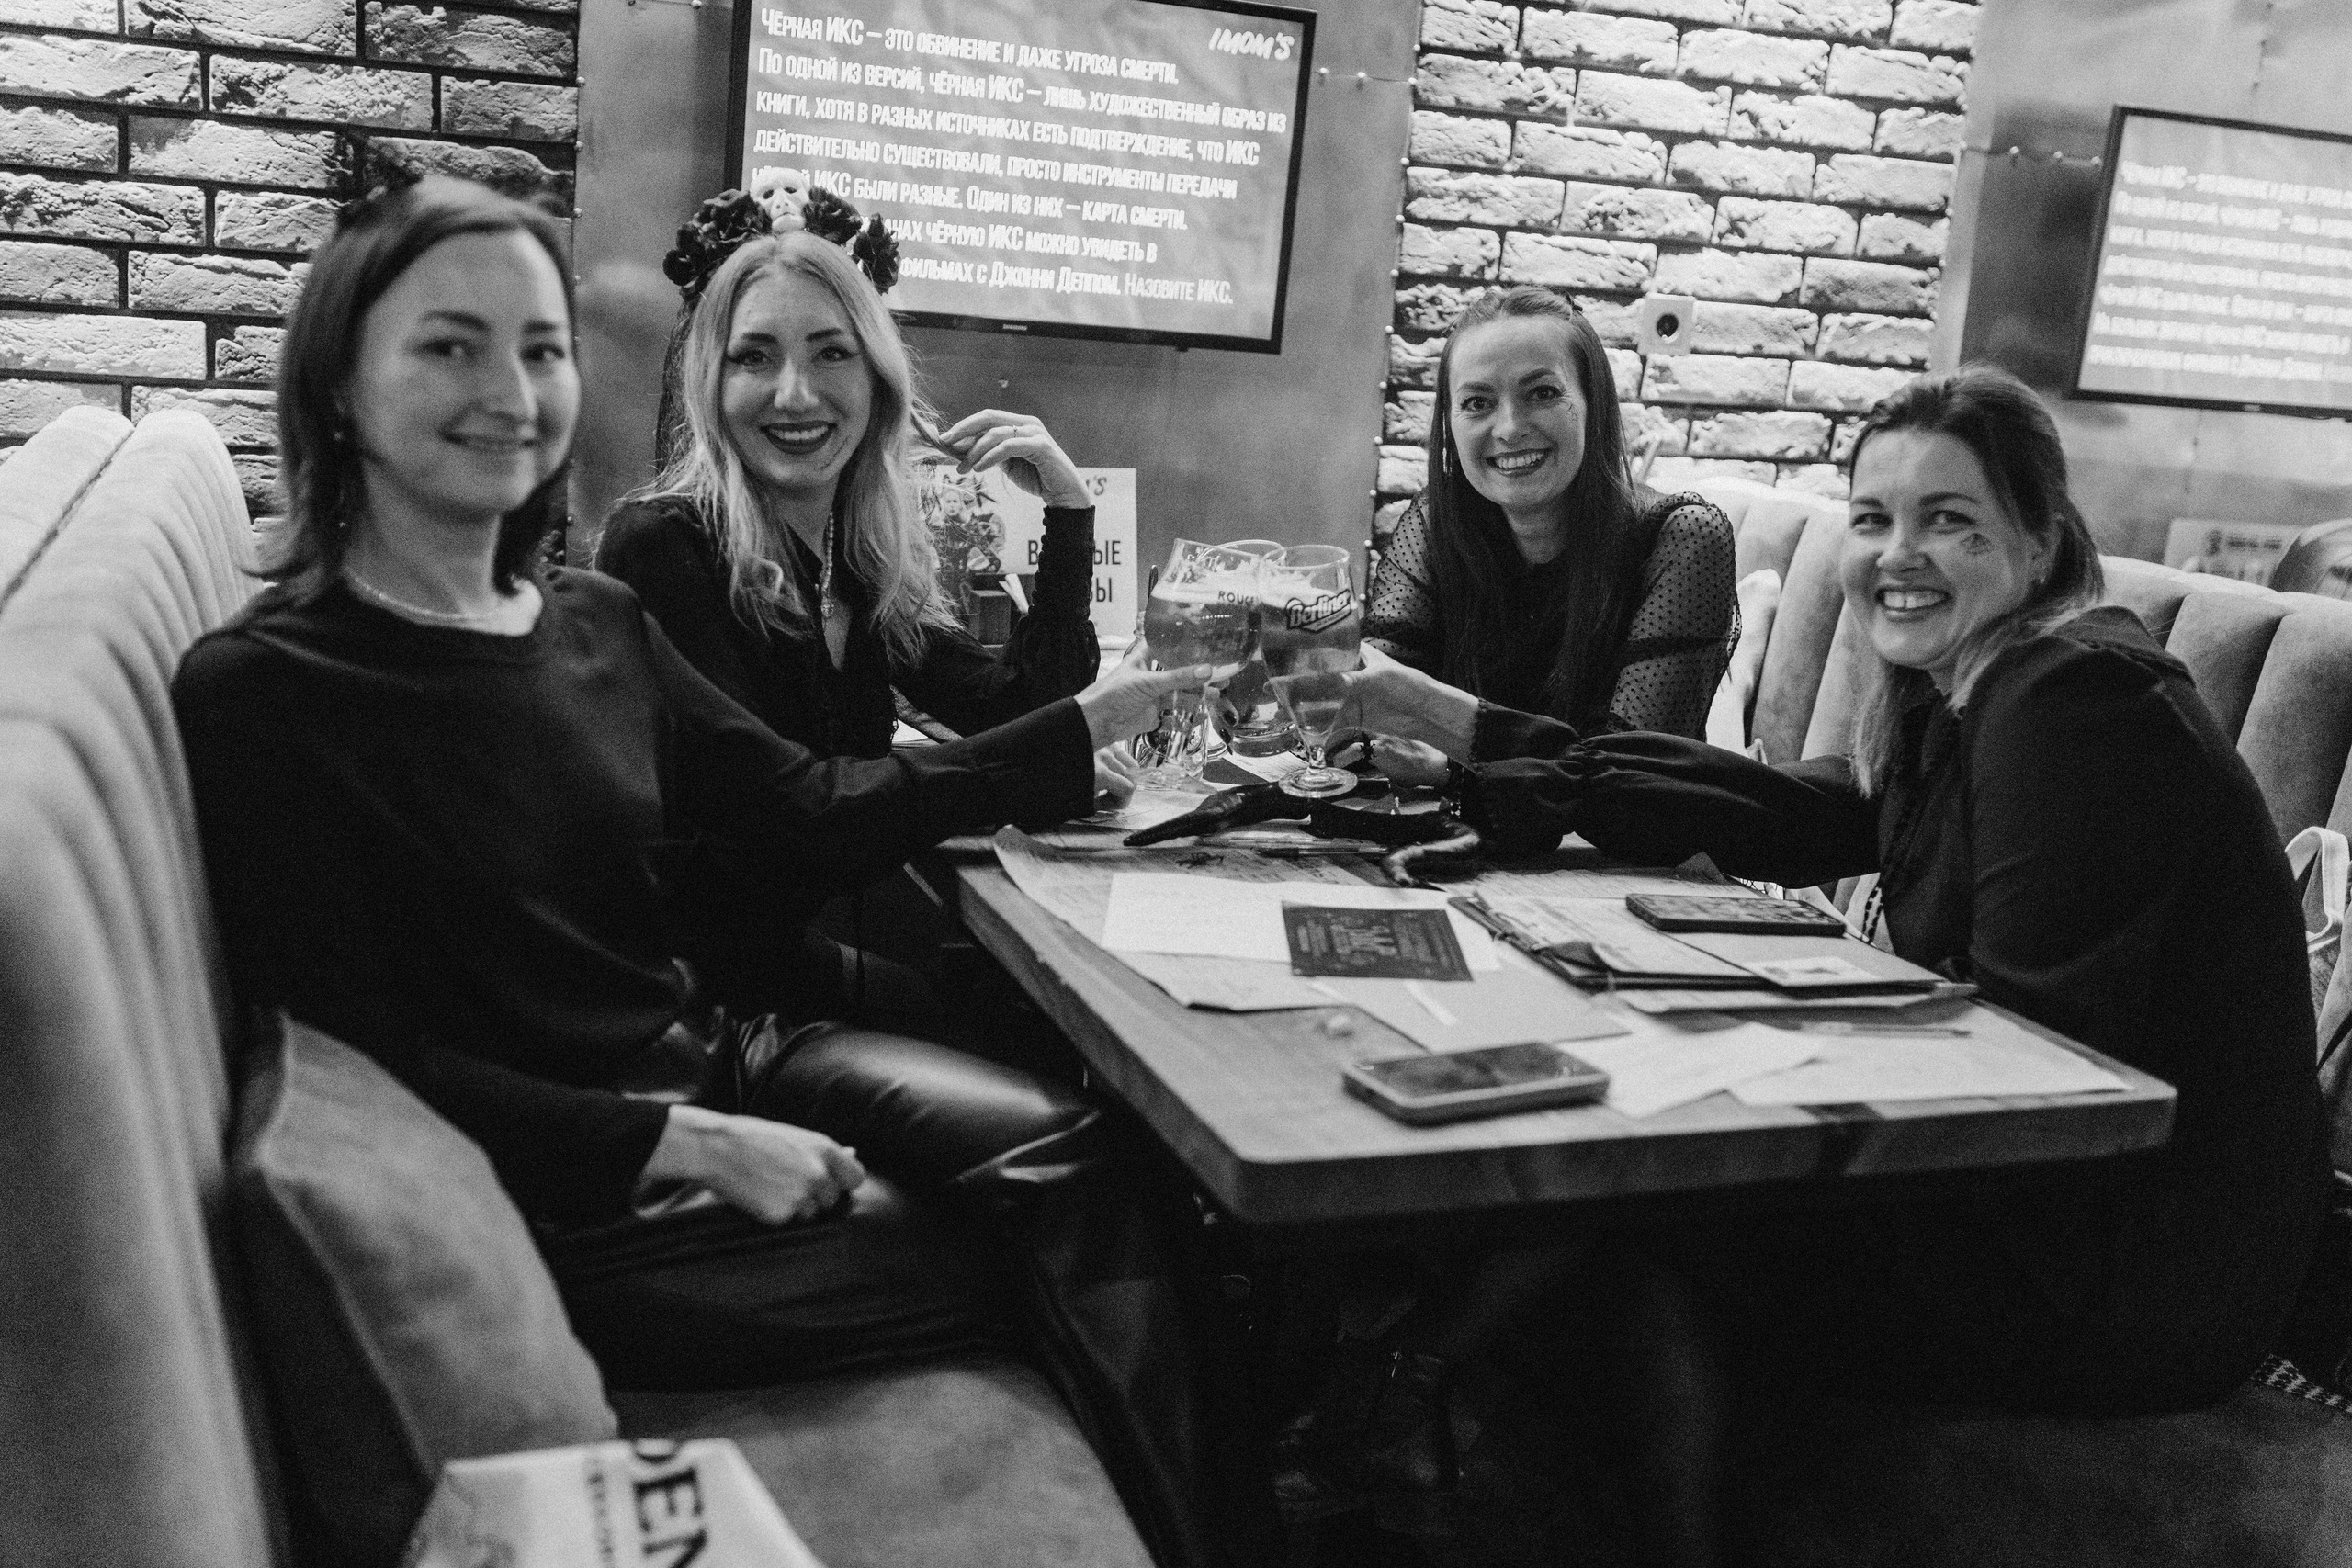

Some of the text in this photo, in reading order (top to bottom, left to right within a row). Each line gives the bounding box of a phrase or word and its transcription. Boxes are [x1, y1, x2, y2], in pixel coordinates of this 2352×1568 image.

[826, 16, 864, 46] ИКС
[885, 28, 915, 52] ЭТО
[916, 31, 1001, 63] ОБВИНЕНИЕ
[1002, 42, 1015, 64] И
[1016, 44, 1063, 70] ДАЖЕ
[1064, 51, 1118, 77] УГРОЗА
[1120, 58, 1179, 85] СМЕРТИ.
[756, 91, 811, 119] КНИГИ,
[814, 97, 855, 122] ХОТЯ
[856, 102, 869, 123] В
[871, 104, 933, 130] РАЗНЫХ
[935, 111, 1031, 141] ИСТОЧНИКАХ
[1032, 121, 1069, 145] ЕСТЬ
[1196, 140, 1225, 163] ЧТО
[1225, 139, 1260, 166] ИКС
[785, 55, 839, 82] ОДНОЙ
[840, 62, 862, 85] ИЗ
[864, 64, 925, 95] ВЕРСИЙ,
[988, 74, 1025, 103] ИКС
[1221, 107, 1266, 131] ОБРАЗ
[1267, 112, 1287, 133] ИЗ
[753, 128, 881, 163] ДЕЙСТВИТЕЛЬНО
[1006, 156, 1061, 182] ПРОСТО
[1062, 162, 1165, 192] ИНСТРУМЕНТЫ
[1166, 173, 1238, 199] ПЕРЕДАЧИ
[854, 177, 899, 202] БЫЛИ
[899, 182, 964, 209] РАЗНЫЕ.
[1011, 193, 1032, 215] ИЗ
[1033, 196, 1064, 219] НИХ
[1081, 200, 1128, 225] КАРТА
[1130, 205, 1188, 231] СМЕРТИ.
[987, 223, 1024, 251] ИКС
[1024, 231, 1080, 256] МОЖНО
[1080, 236, 1145, 262] УВИДЕТЬ
[1146, 243, 1158, 264] В
[976, 263, 989, 285] С
[1196, 278, 1234, 304] ИКС.
